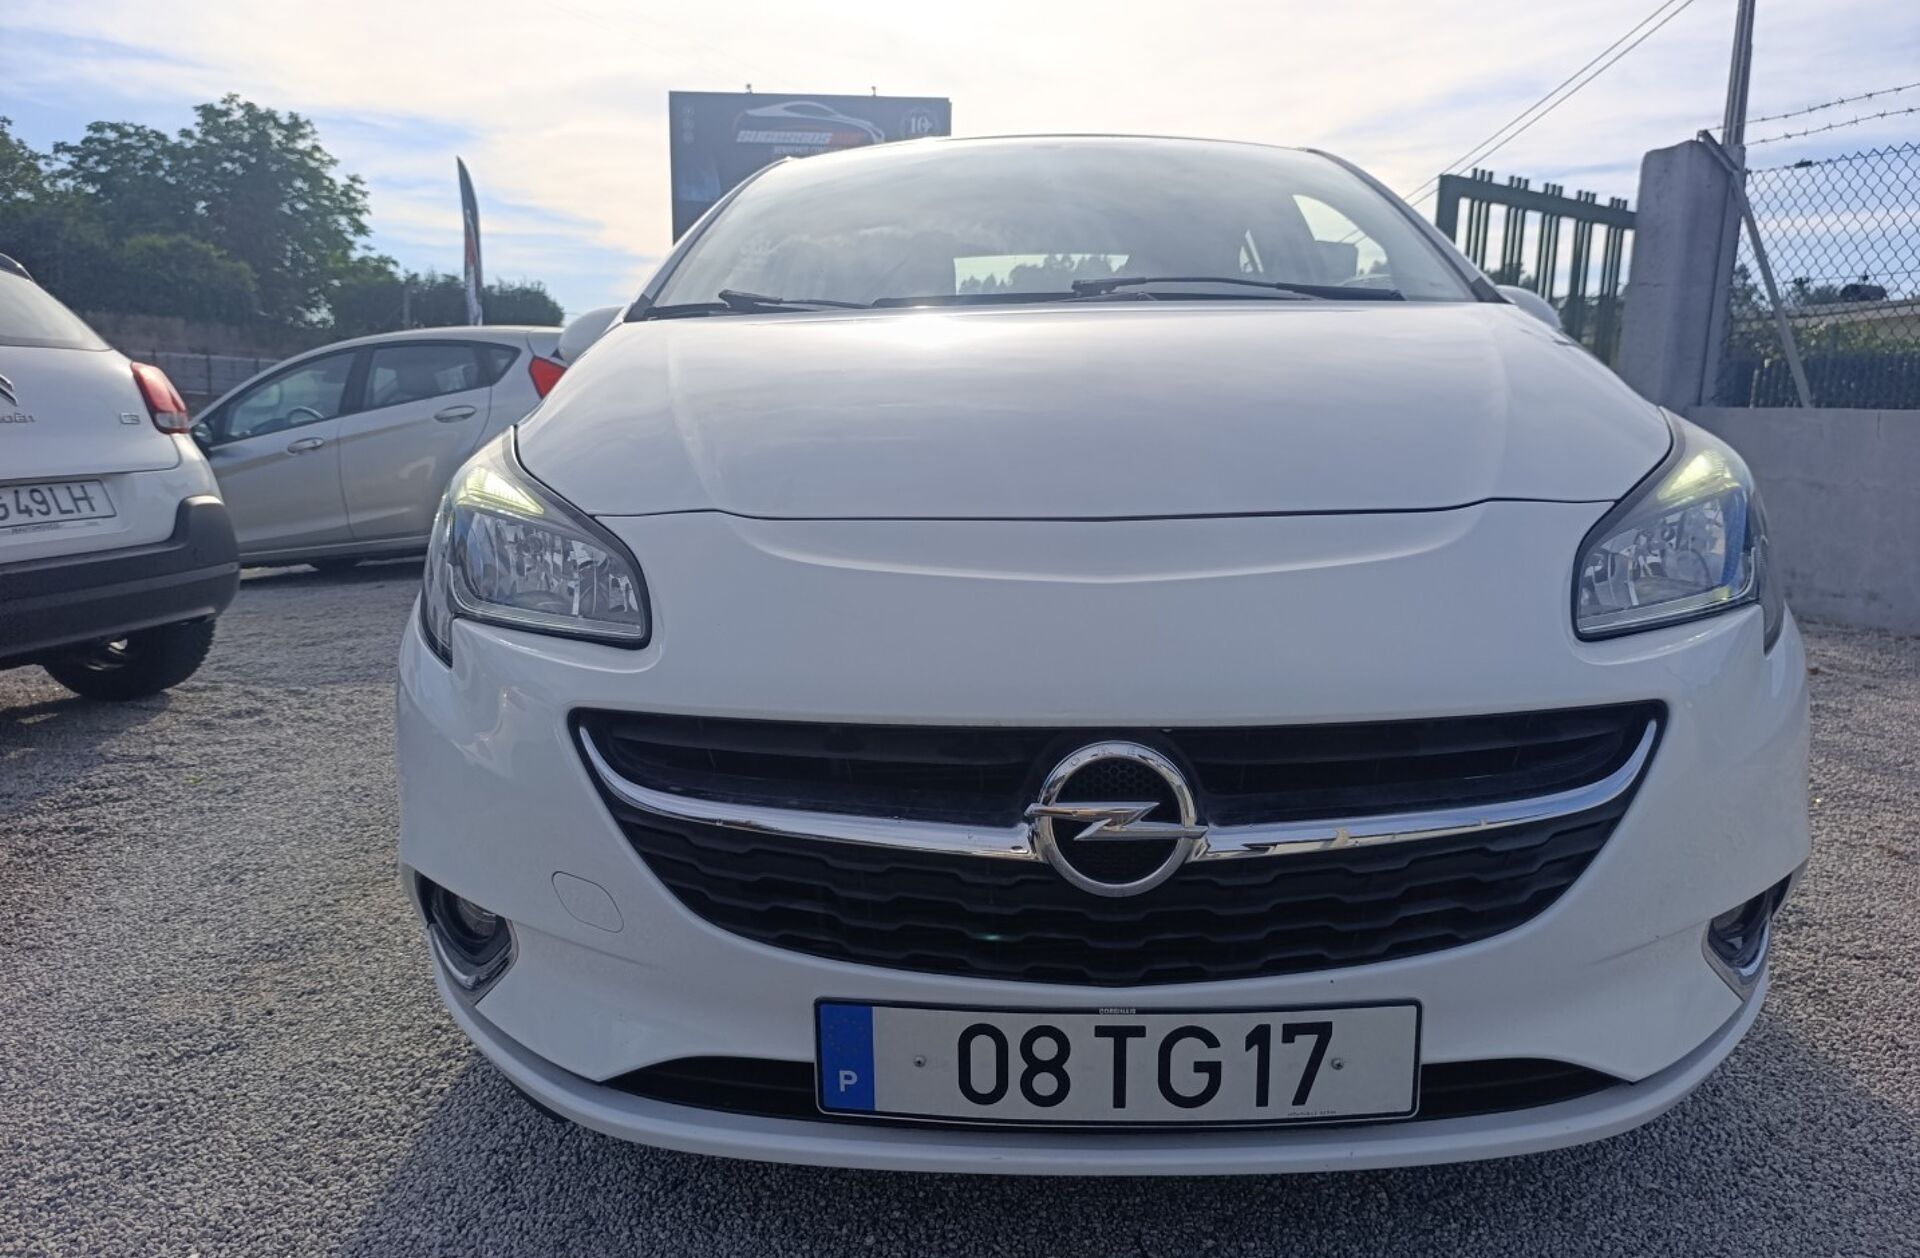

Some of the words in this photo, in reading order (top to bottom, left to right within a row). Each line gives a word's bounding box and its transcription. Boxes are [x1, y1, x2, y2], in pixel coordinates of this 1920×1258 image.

[838, 1070, 858, 1092] P
[958, 1023, 1072, 1107] 08
[1094, 1025, 1223, 1109] TG
[1245, 1021, 1333, 1107] 17
